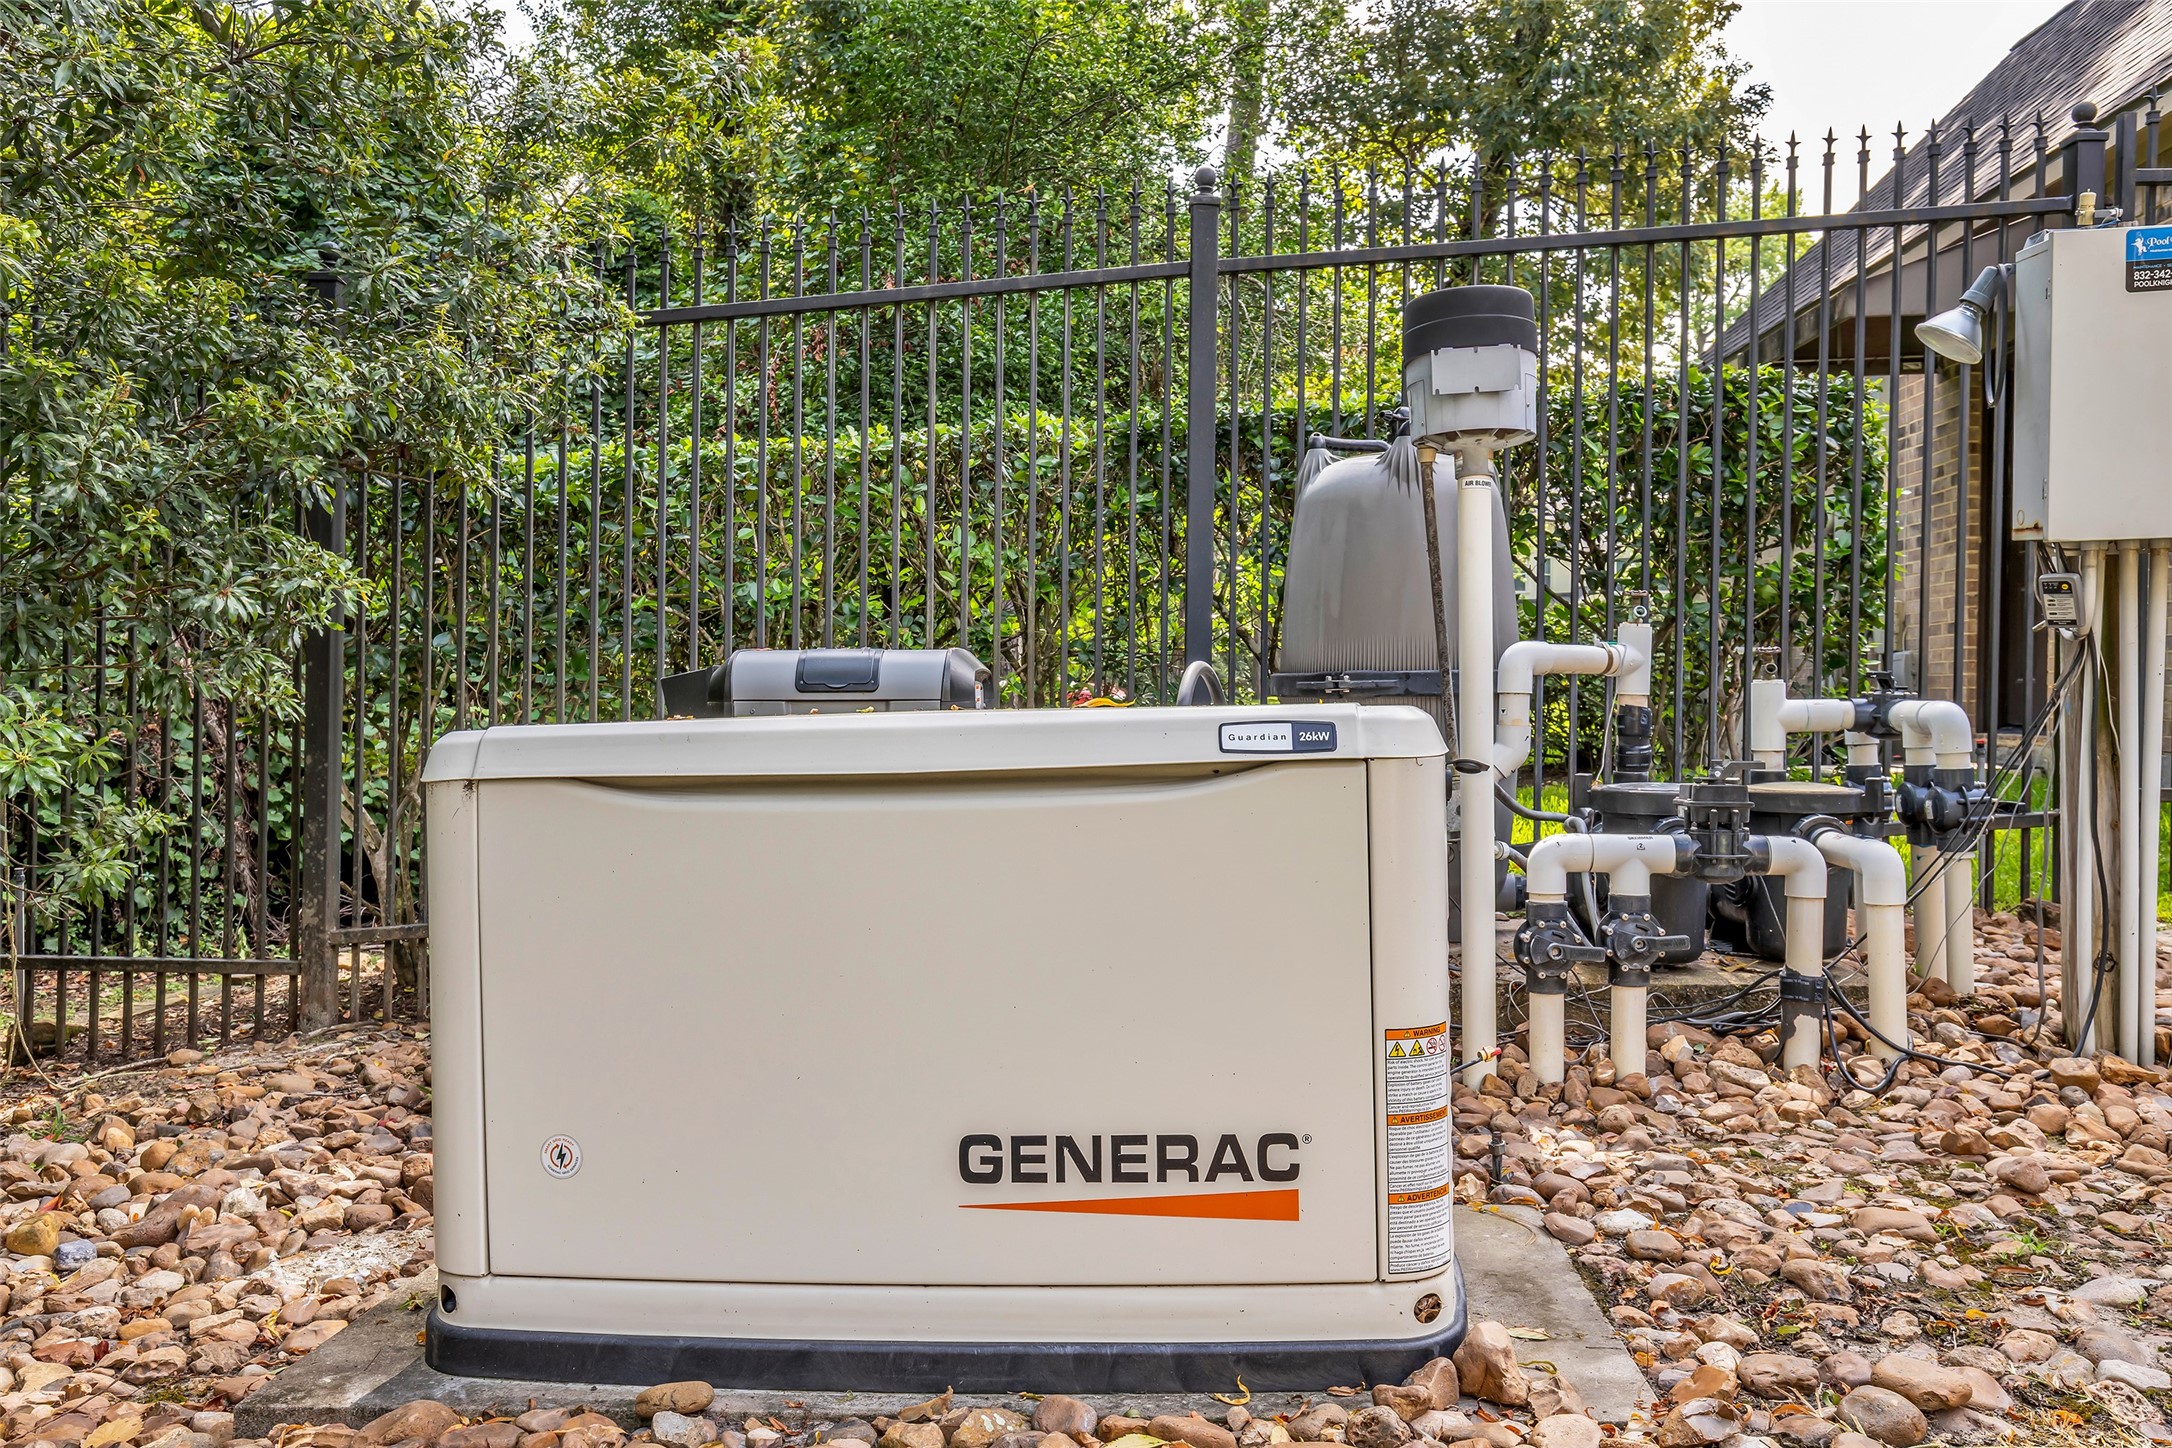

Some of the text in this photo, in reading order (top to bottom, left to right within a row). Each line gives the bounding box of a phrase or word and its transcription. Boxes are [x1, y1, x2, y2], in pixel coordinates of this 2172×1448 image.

[1299, 731, 1330, 741] 26kW
[1413, 1026, 1440, 1036] WARNING
[544, 1141, 552, 1154] SMART
[562, 1138, 574, 1147] READY
[958, 1133, 1300, 1184] GENERAC
[1407, 1187, 1447, 1201] ADVERTENCIA
